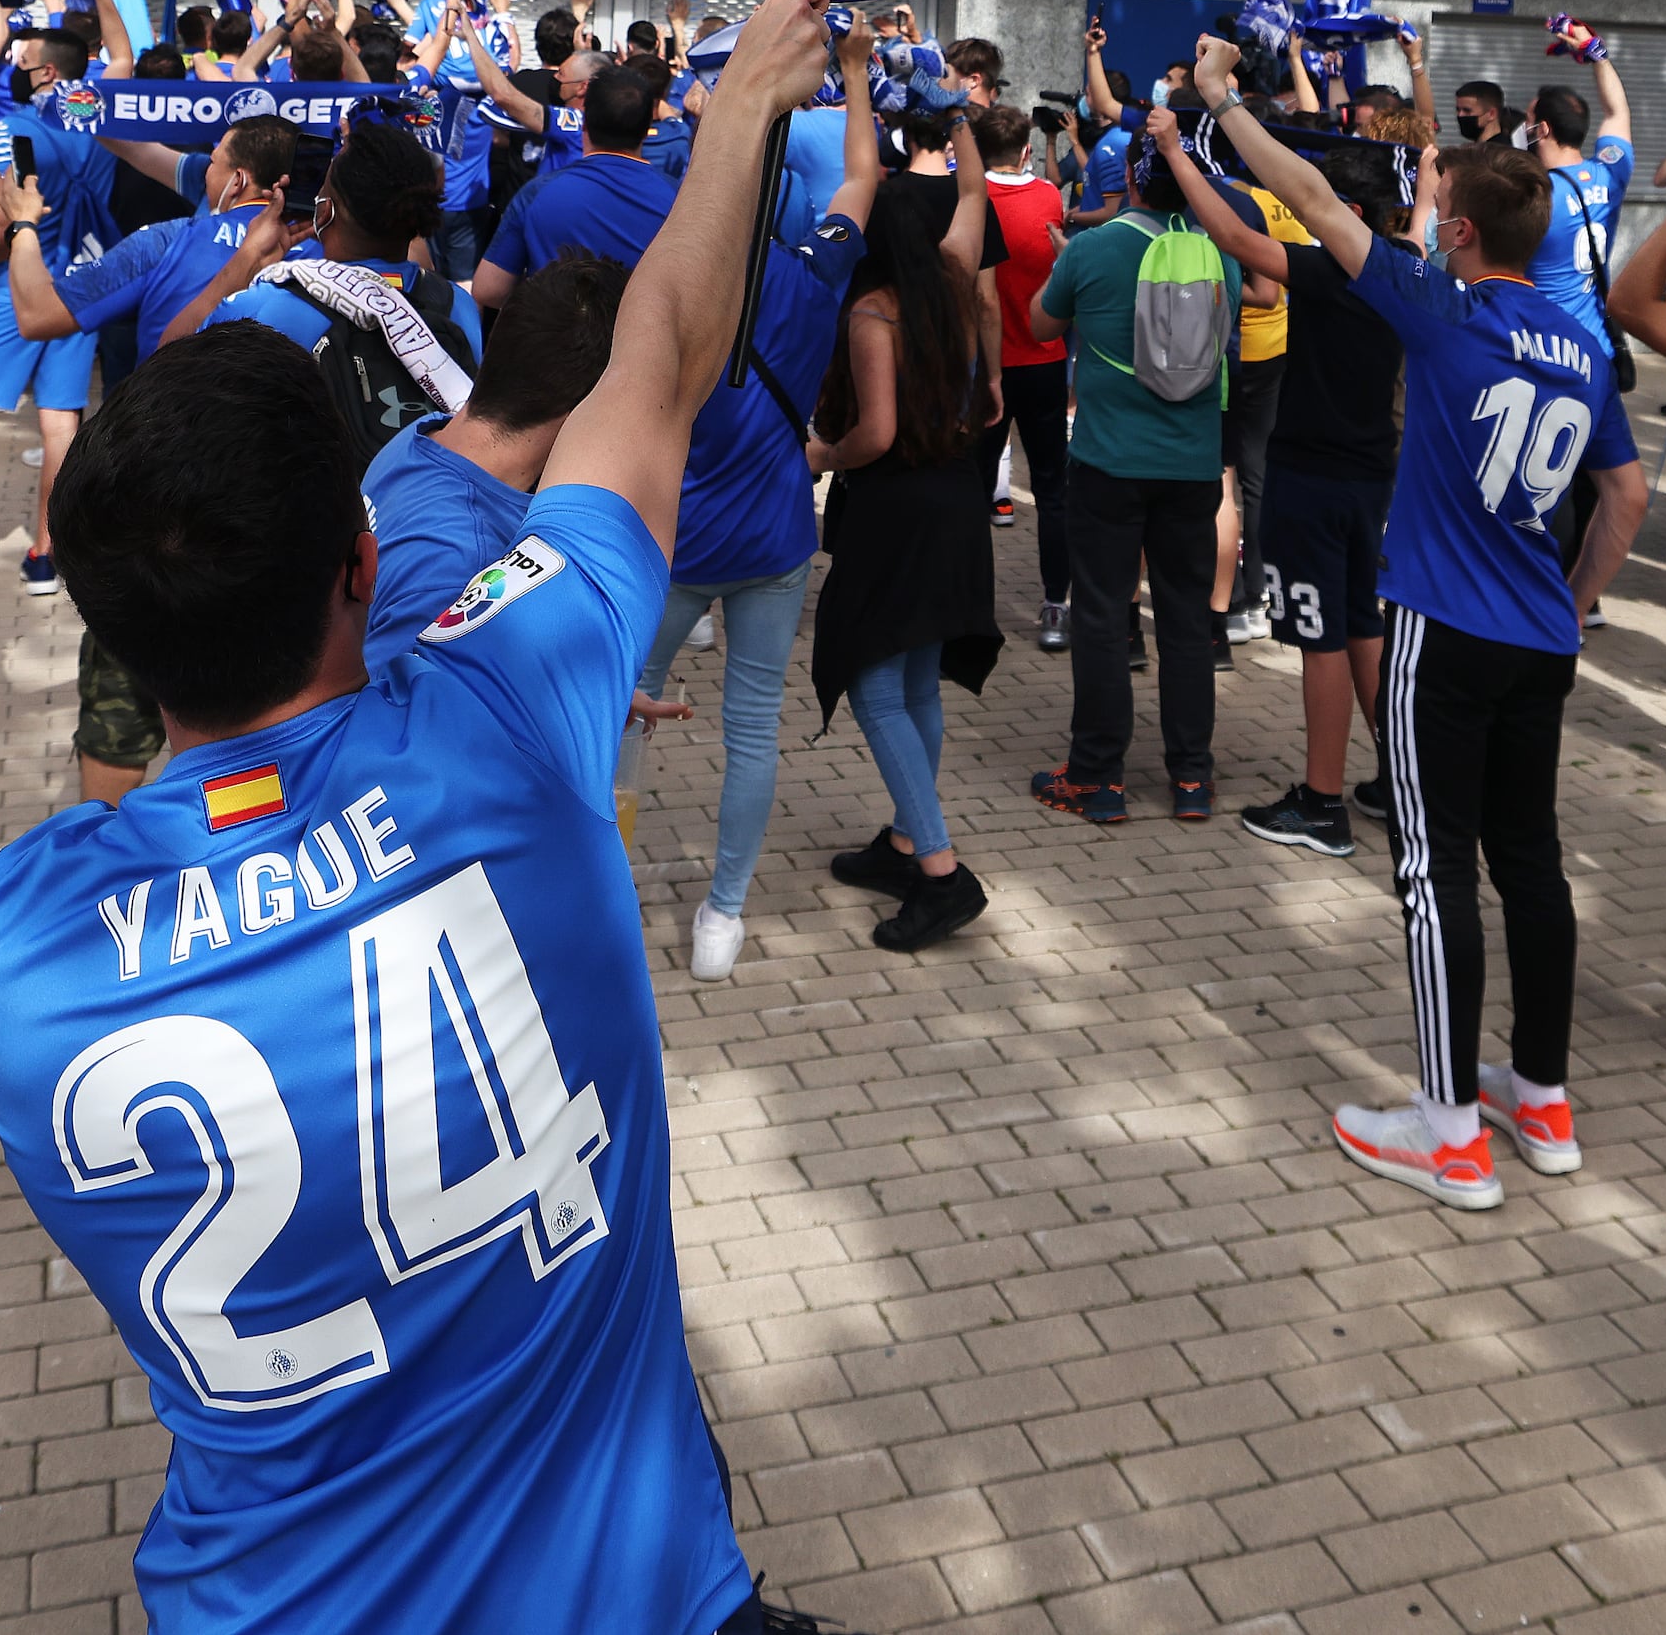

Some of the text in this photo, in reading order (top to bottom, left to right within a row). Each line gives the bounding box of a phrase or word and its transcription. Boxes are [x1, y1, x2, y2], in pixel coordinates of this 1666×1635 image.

[113, 91, 223, 124] EURO
[1471, 377, 1592, 534] 19
[97, 784, 420, 982] YAGUE
[52, 860, 611, 1413] 24
